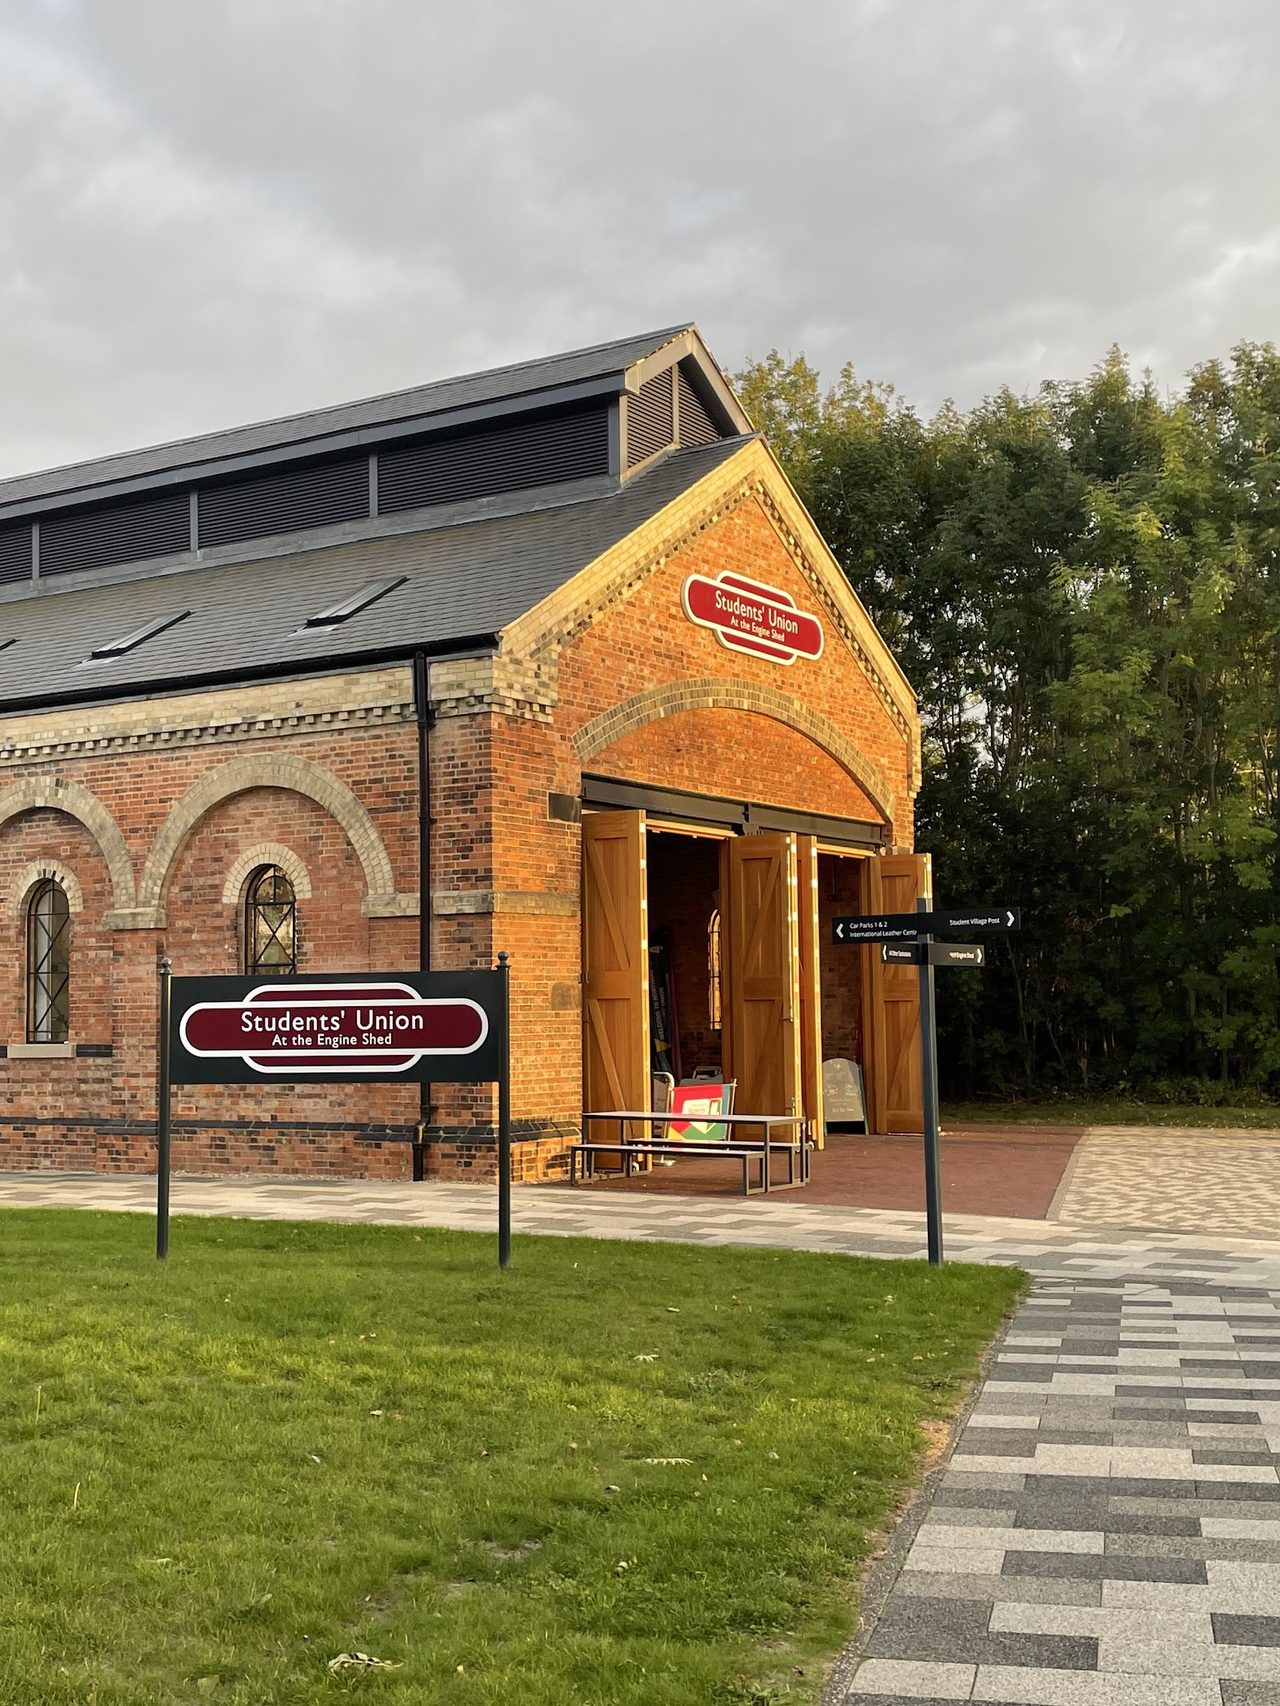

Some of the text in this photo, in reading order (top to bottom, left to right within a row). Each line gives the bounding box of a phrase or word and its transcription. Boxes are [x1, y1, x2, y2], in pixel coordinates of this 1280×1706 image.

[715, 590, 798, 634] Students' Union
[730, 616, 785, 642] At the Engine Shed
[970, 918, 987, 926] Village
[882, 929, 902, 937] Leather
[241, 1009, 424, 1032] Students' Union
[272, 1032, 392, 1048] At the Engine Shed
